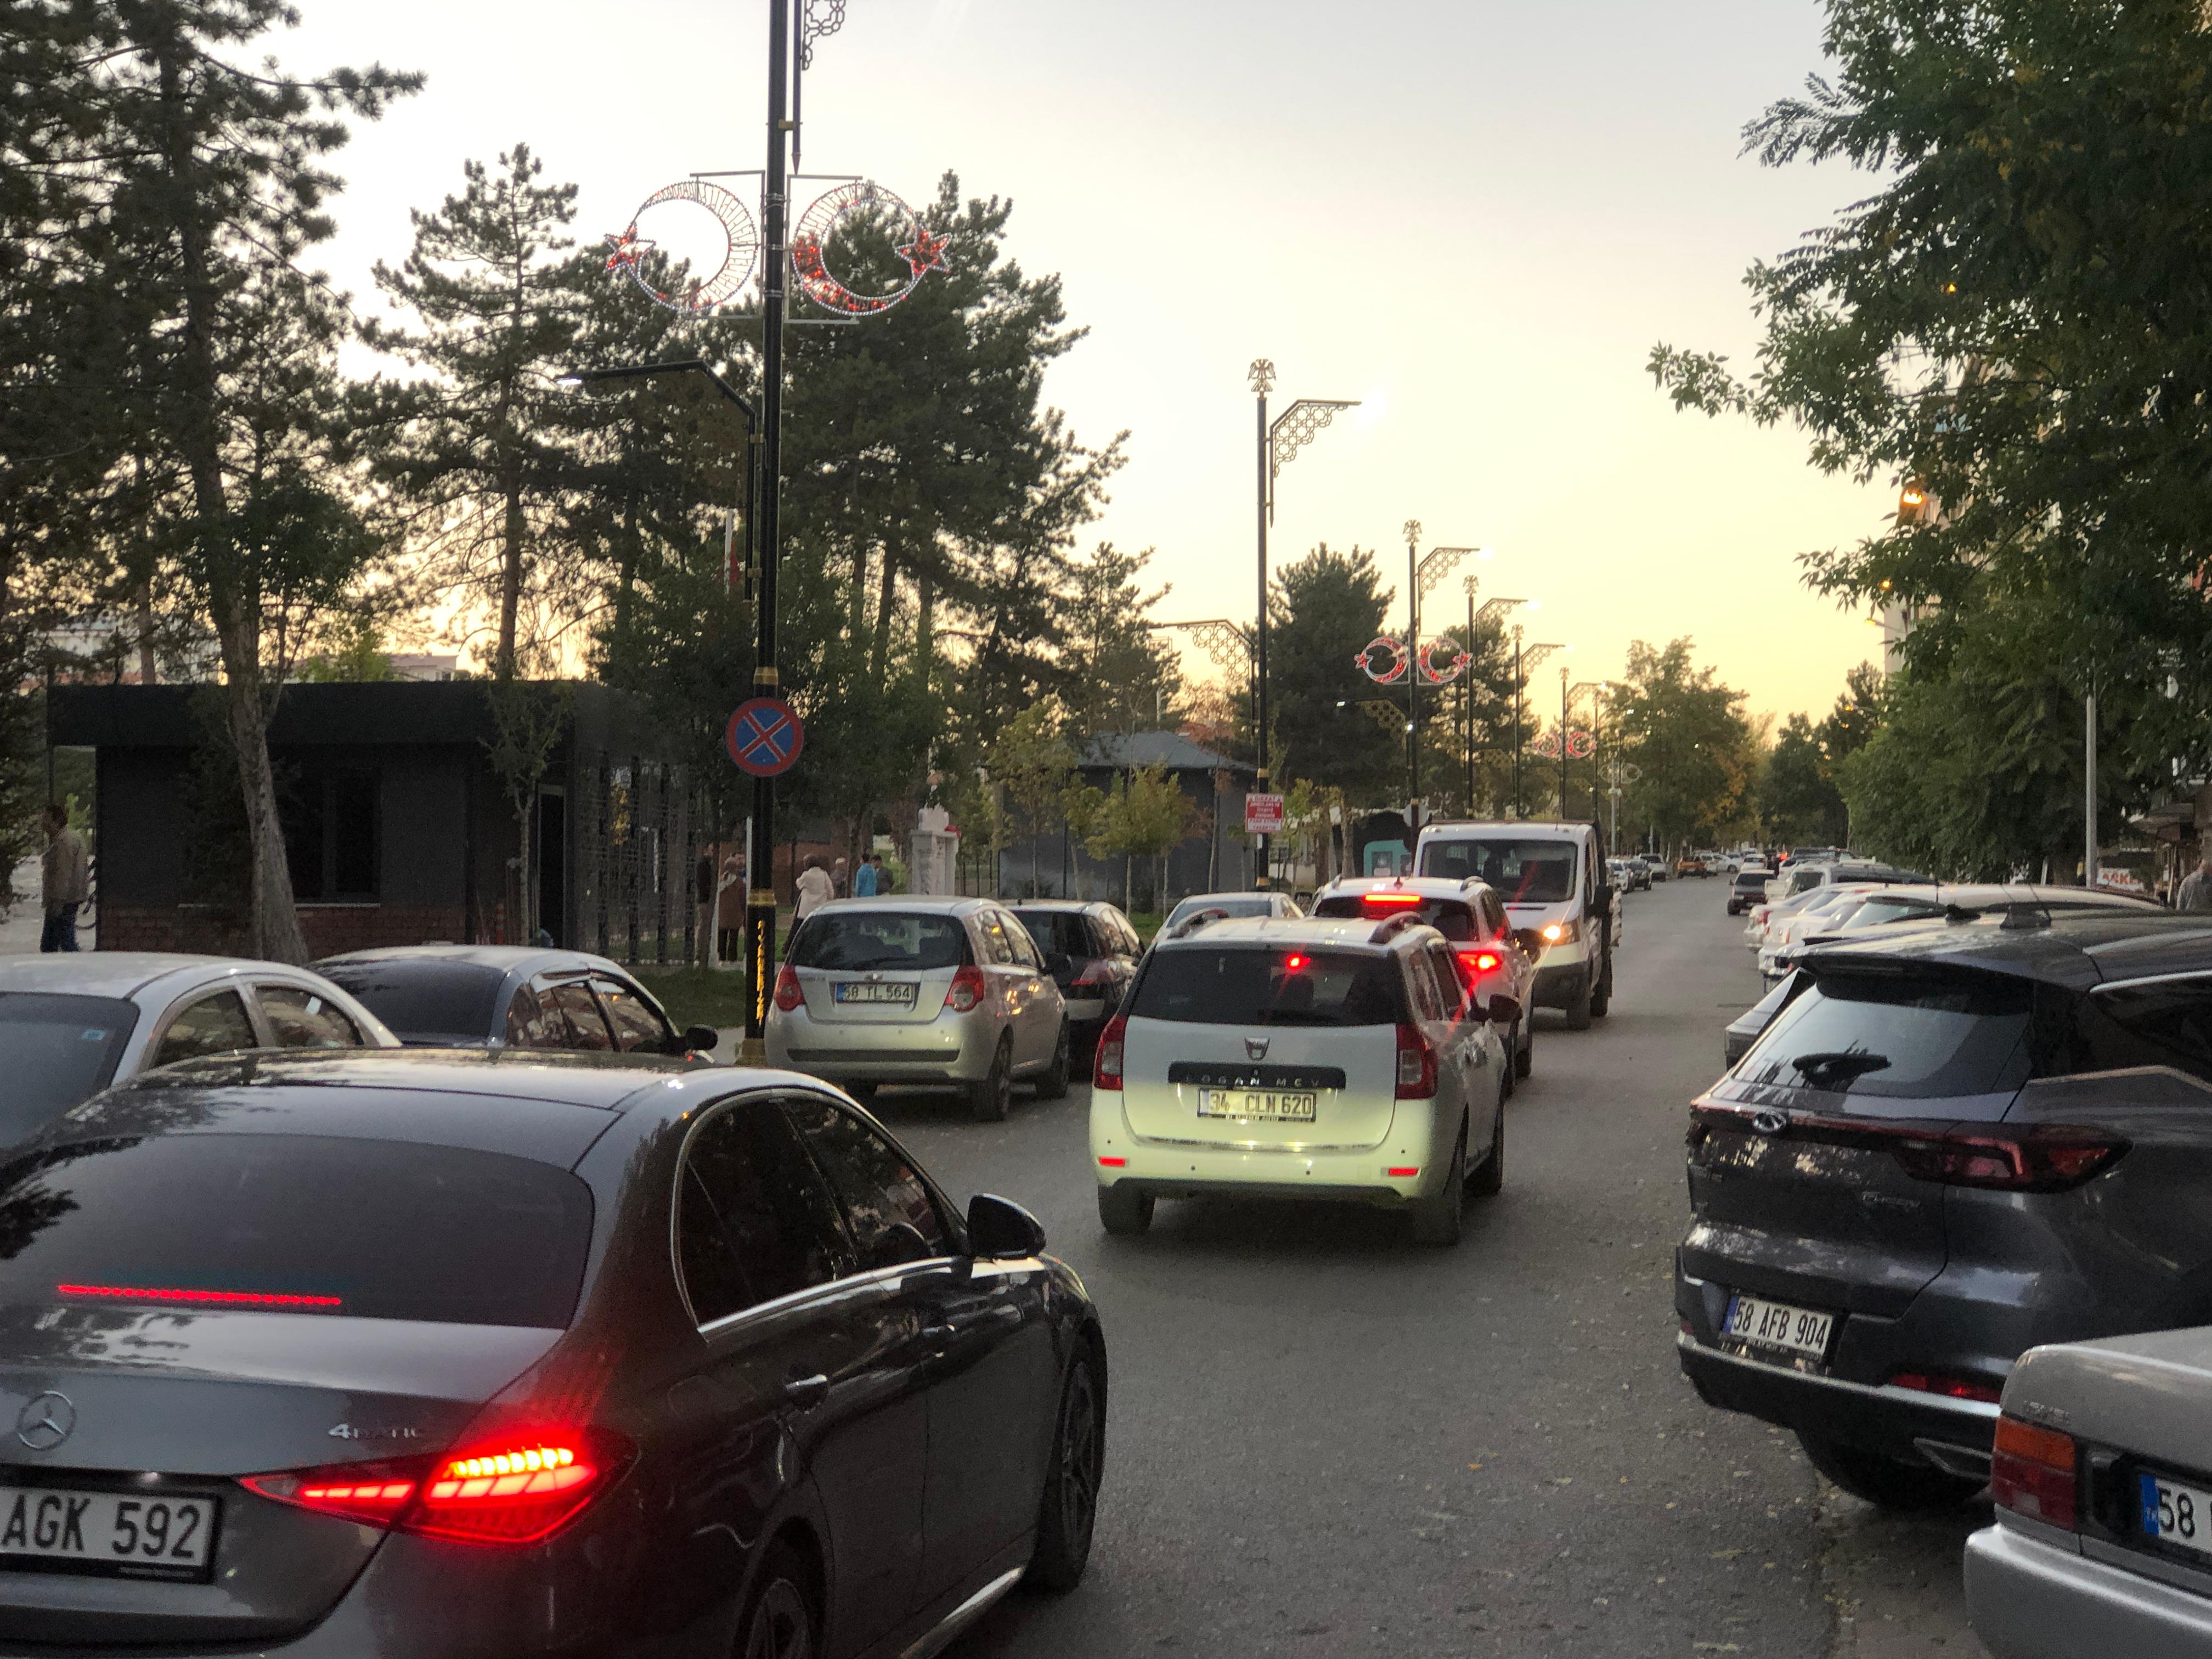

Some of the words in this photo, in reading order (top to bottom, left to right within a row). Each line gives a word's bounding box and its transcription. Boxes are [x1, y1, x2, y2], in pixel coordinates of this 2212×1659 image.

[867, 985, 882, 999] TL
[887, 985, 909, 999] 564
[1245, 1093, 1276, 1113] CLN
[1281, 1096, 1311, 1114] 620
[1734, 1301, 1754, 1332] 58
[1758, 1306, 1791, 1340] AFB
[1795, 1313, 1829, 1349] 904
[1, 1494, 91, 1552] AGK
[111, 1501, 201, 1559] 592
[2158, 1487, 2196, 1539] 58
